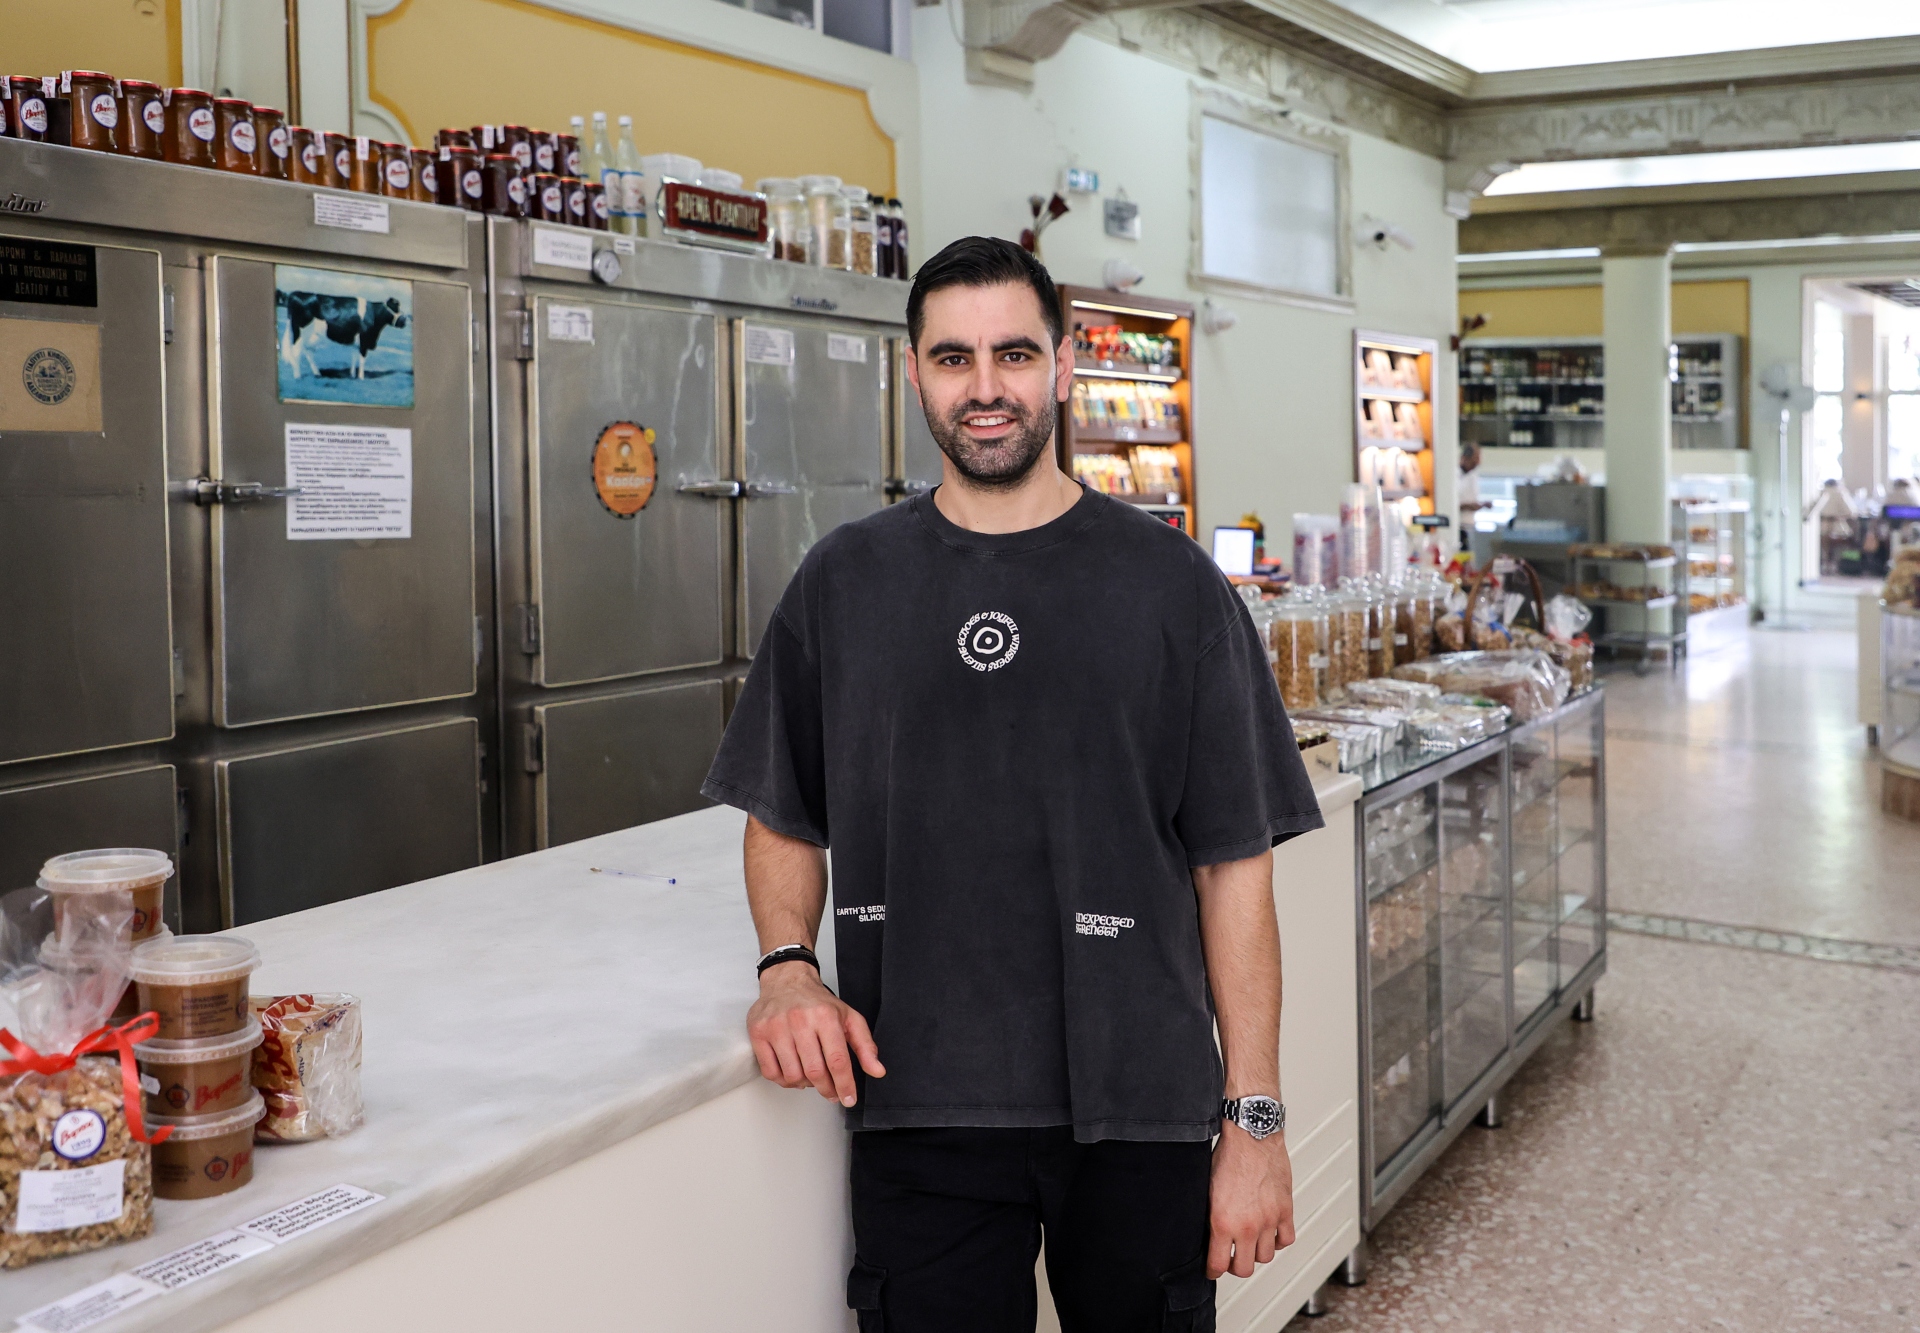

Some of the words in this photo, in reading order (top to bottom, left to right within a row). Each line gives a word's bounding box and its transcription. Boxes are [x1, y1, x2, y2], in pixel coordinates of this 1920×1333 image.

[987, 611, 1019, 634] JOYFUL
[1075, 912, 1135, 928] UNEXPECTED
[1075, 923, 1119, 939] STRENGTH
